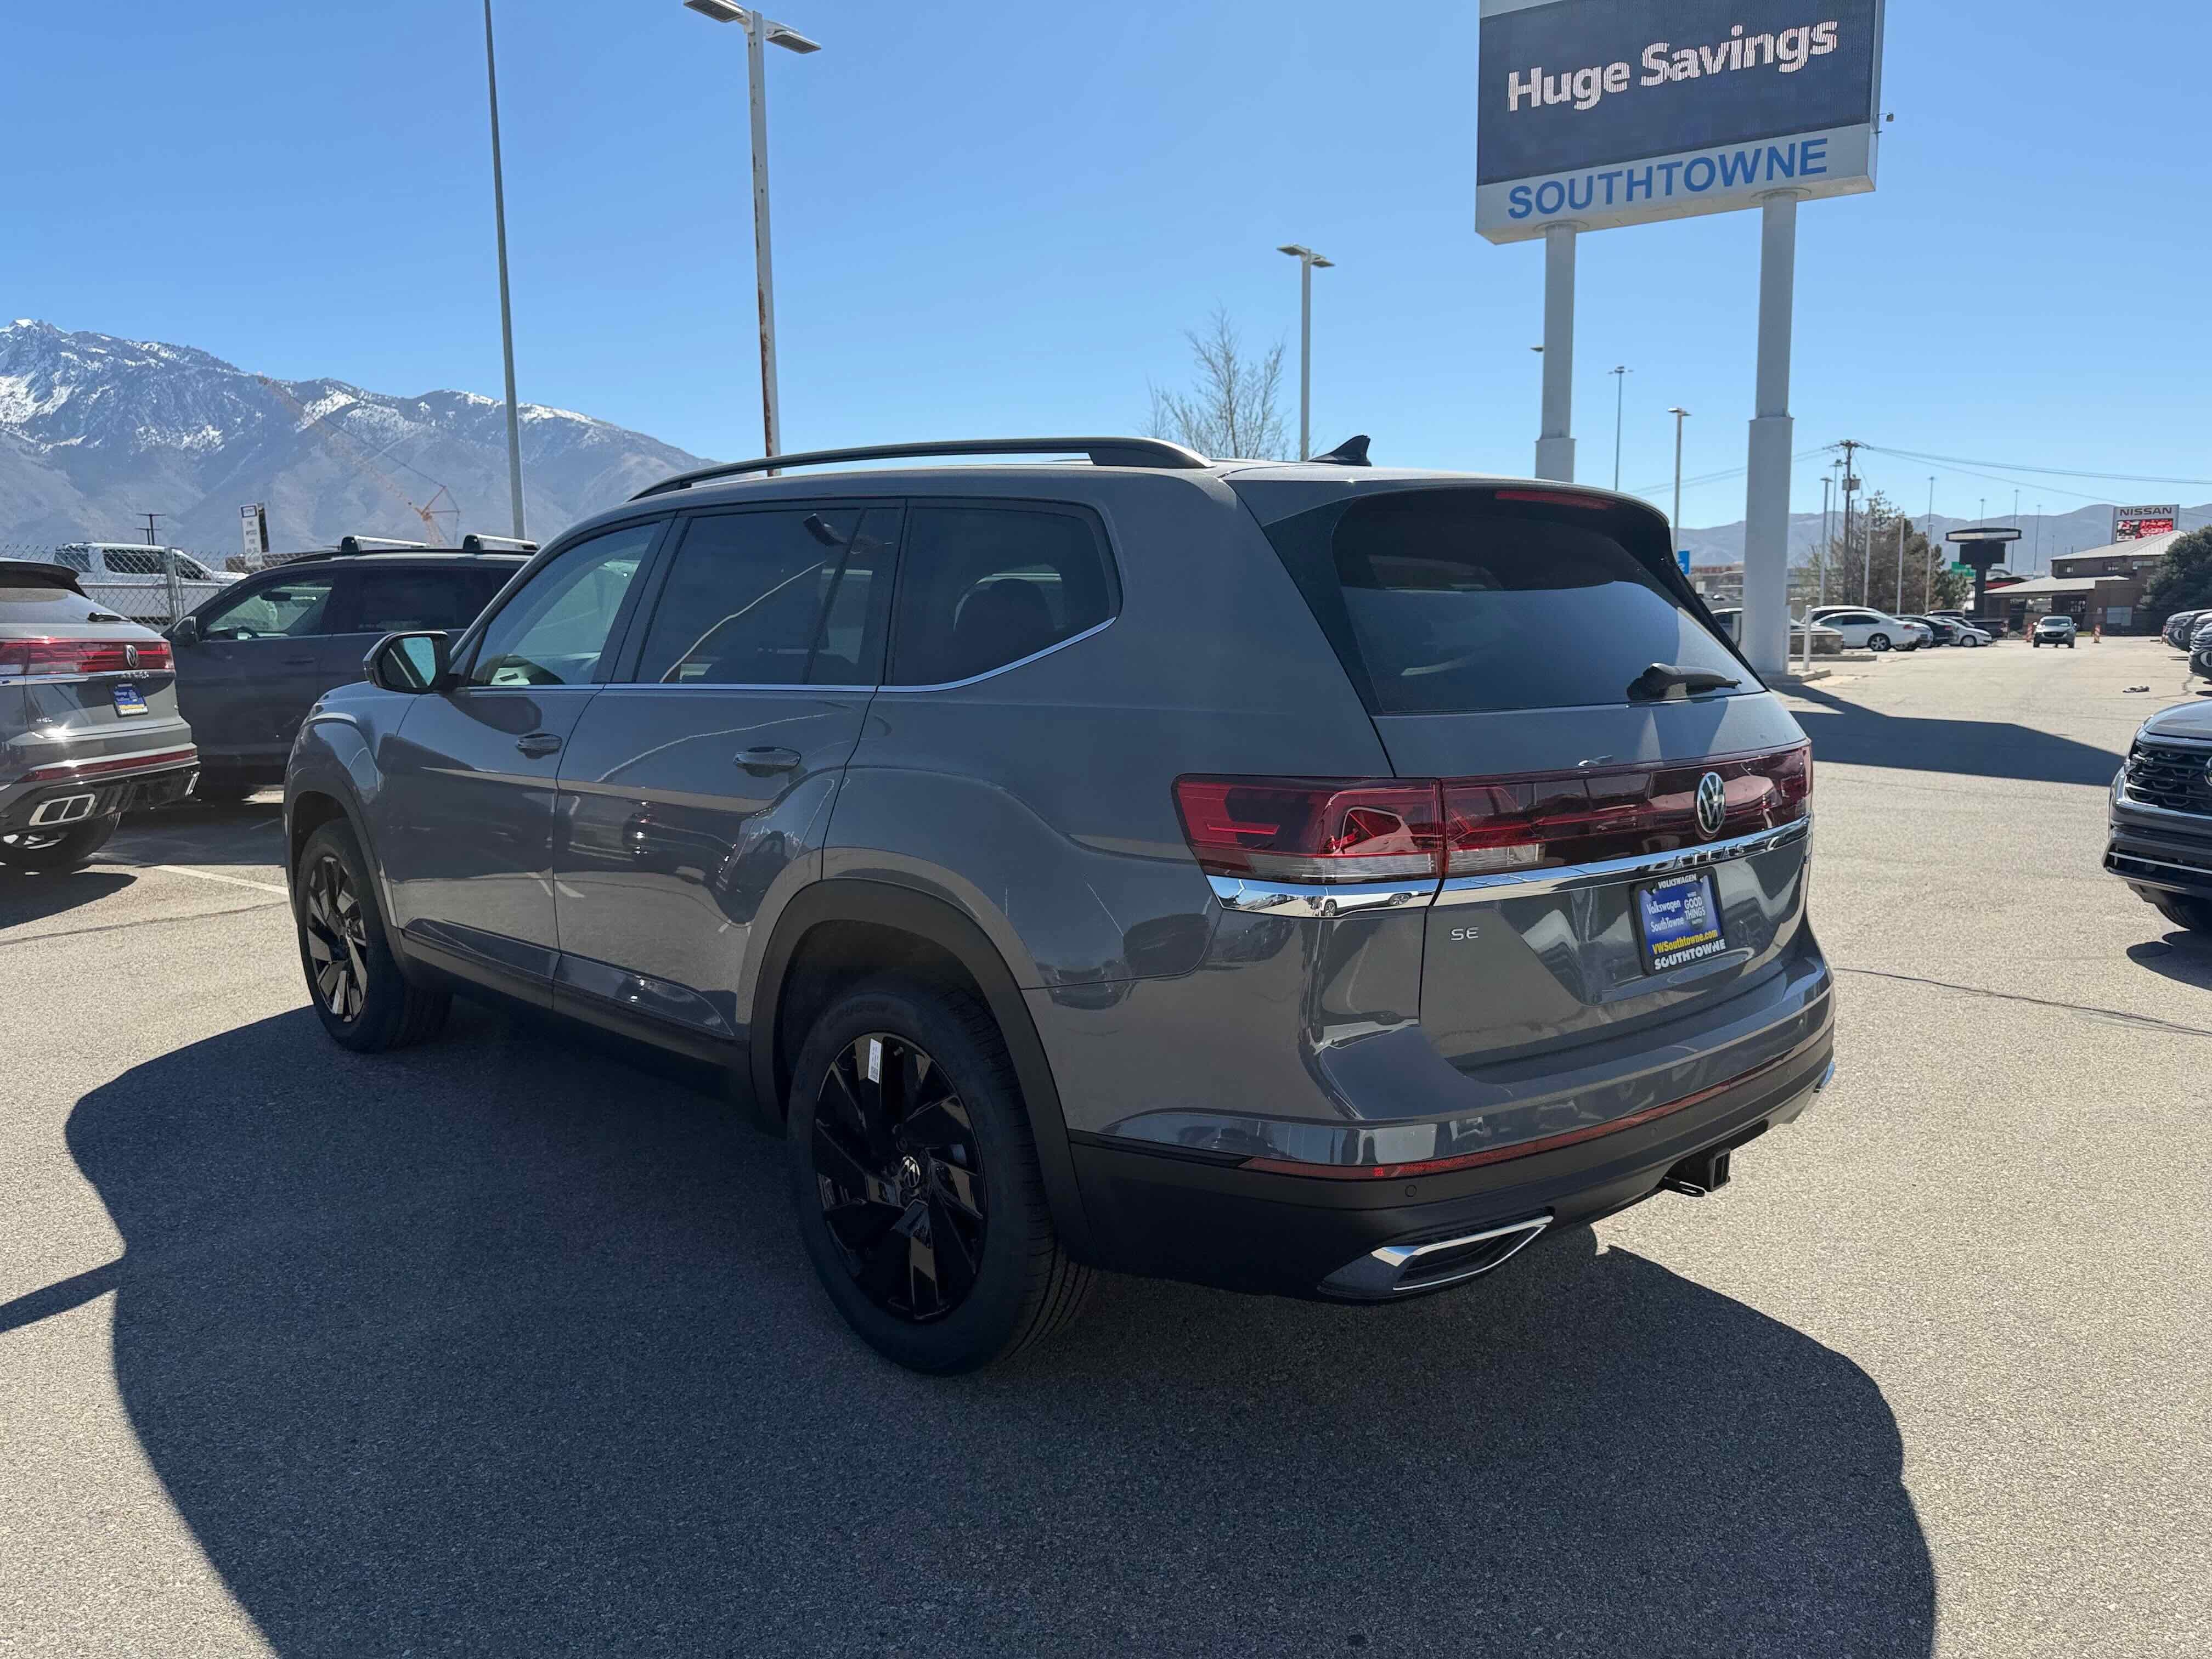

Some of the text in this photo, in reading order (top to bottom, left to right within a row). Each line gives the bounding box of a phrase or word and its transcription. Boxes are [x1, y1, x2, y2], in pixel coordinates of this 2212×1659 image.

[1508, 20, 1838, 111] Huge Savings
[1508, 138, 1828, 219] SOUTHTOWNE
[2119, 507, 2172, 516] NISSAN
[1673, 843, 1745, 869] ATLAS
[1657, 873, 1697, 889] VOLKSWAGEN
[1646, 900, 1681, 915] Volkswagen
[1684, 896, 1702, 910] GOOD
[1684, 906, 1706, 920] THINGS
[1650, 917, 1685, 933] SouthTowne
[1451, 927, 1479, 940] SE
[1652, 930, 1718, 955] VWSouthtowne.com
[1654, 939, 1726, 970] SOUTHTOWNE
